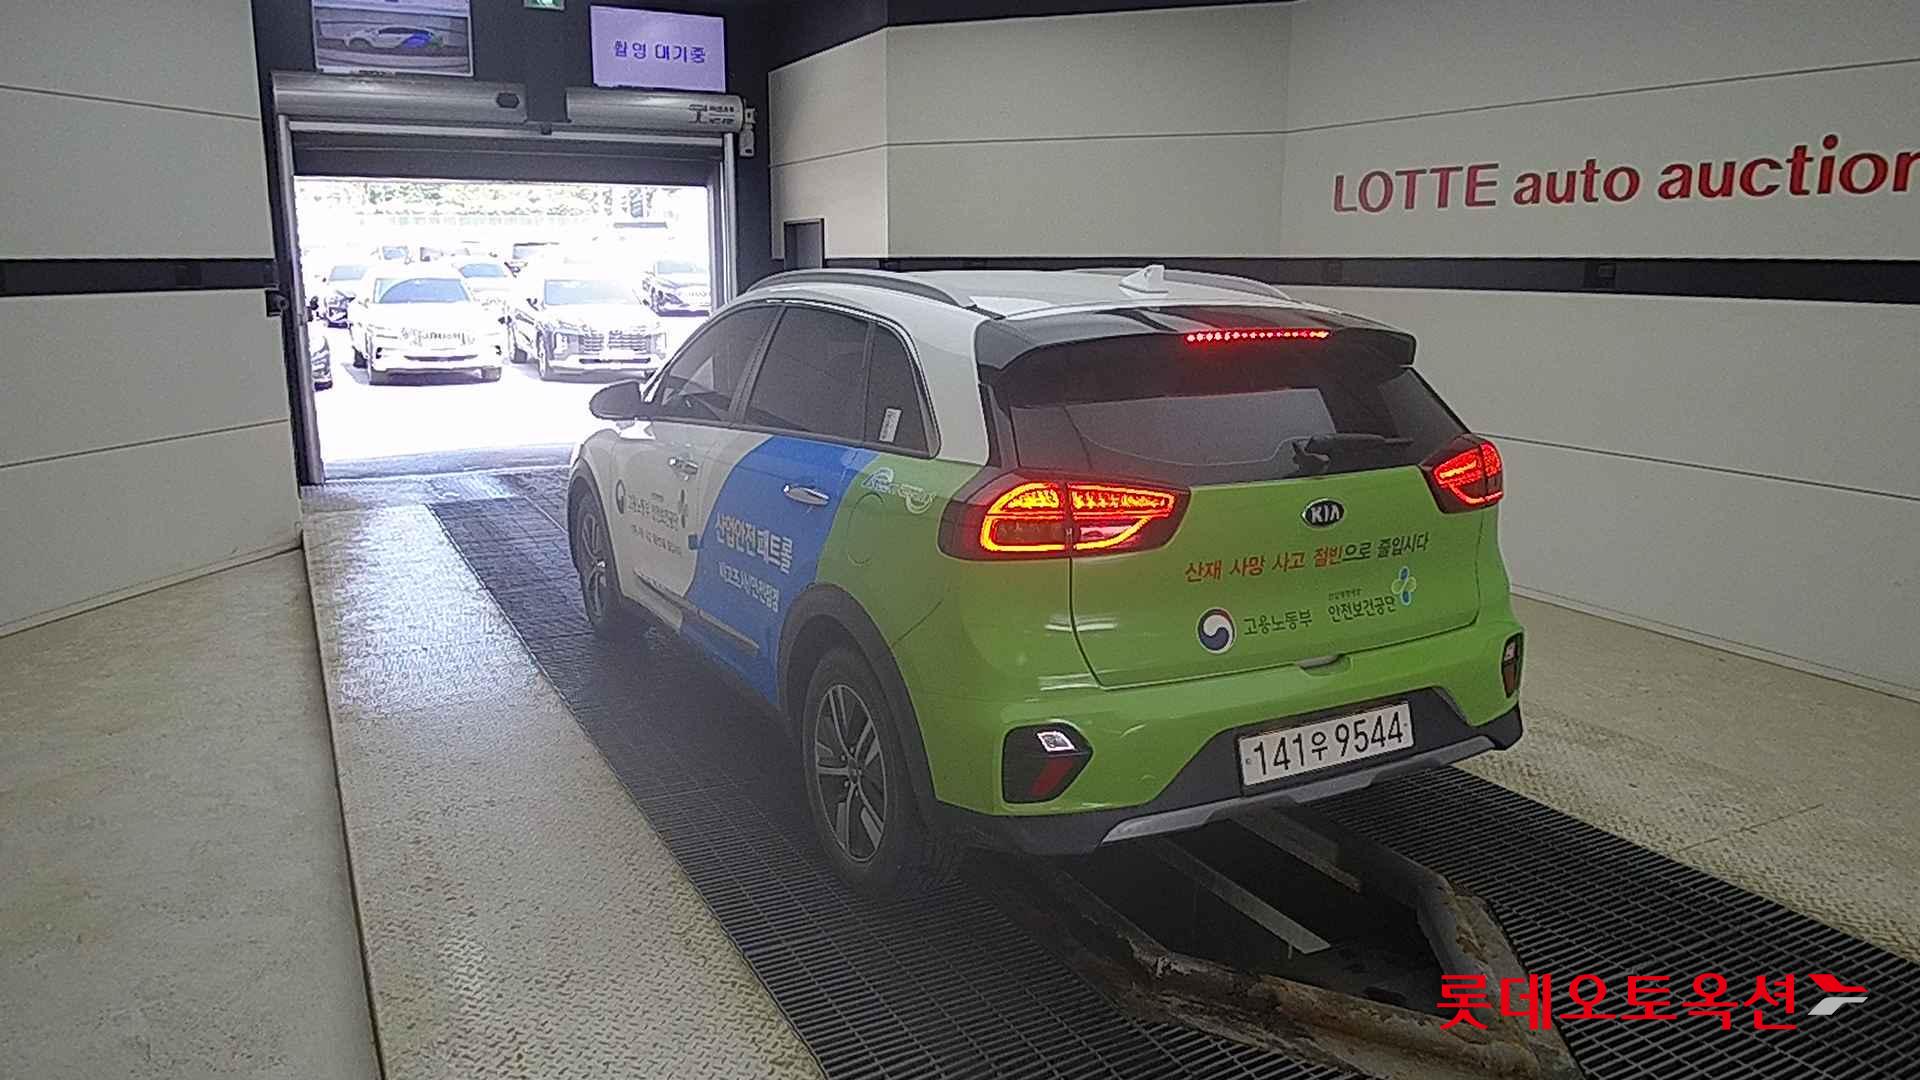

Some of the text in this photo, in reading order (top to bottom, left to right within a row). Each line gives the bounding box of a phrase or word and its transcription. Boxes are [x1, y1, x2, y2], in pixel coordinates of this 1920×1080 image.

[655, 44, 705, 64] 대기중
[1333, 162, 1499, 213] LOTTE
[1513, 158, 1641, 205] auto
[1311, 505, 1341, 524] KIA
[1185, 560, 1222, 583] 산재
[1229, 555, 1265, 577] 사망
[1272, 552, 1305, 573] 사고
[1377, 532, 1429, 559] 줄입시다
[1243, 595, 1397, 636] 고용노동부 안전보건공단
